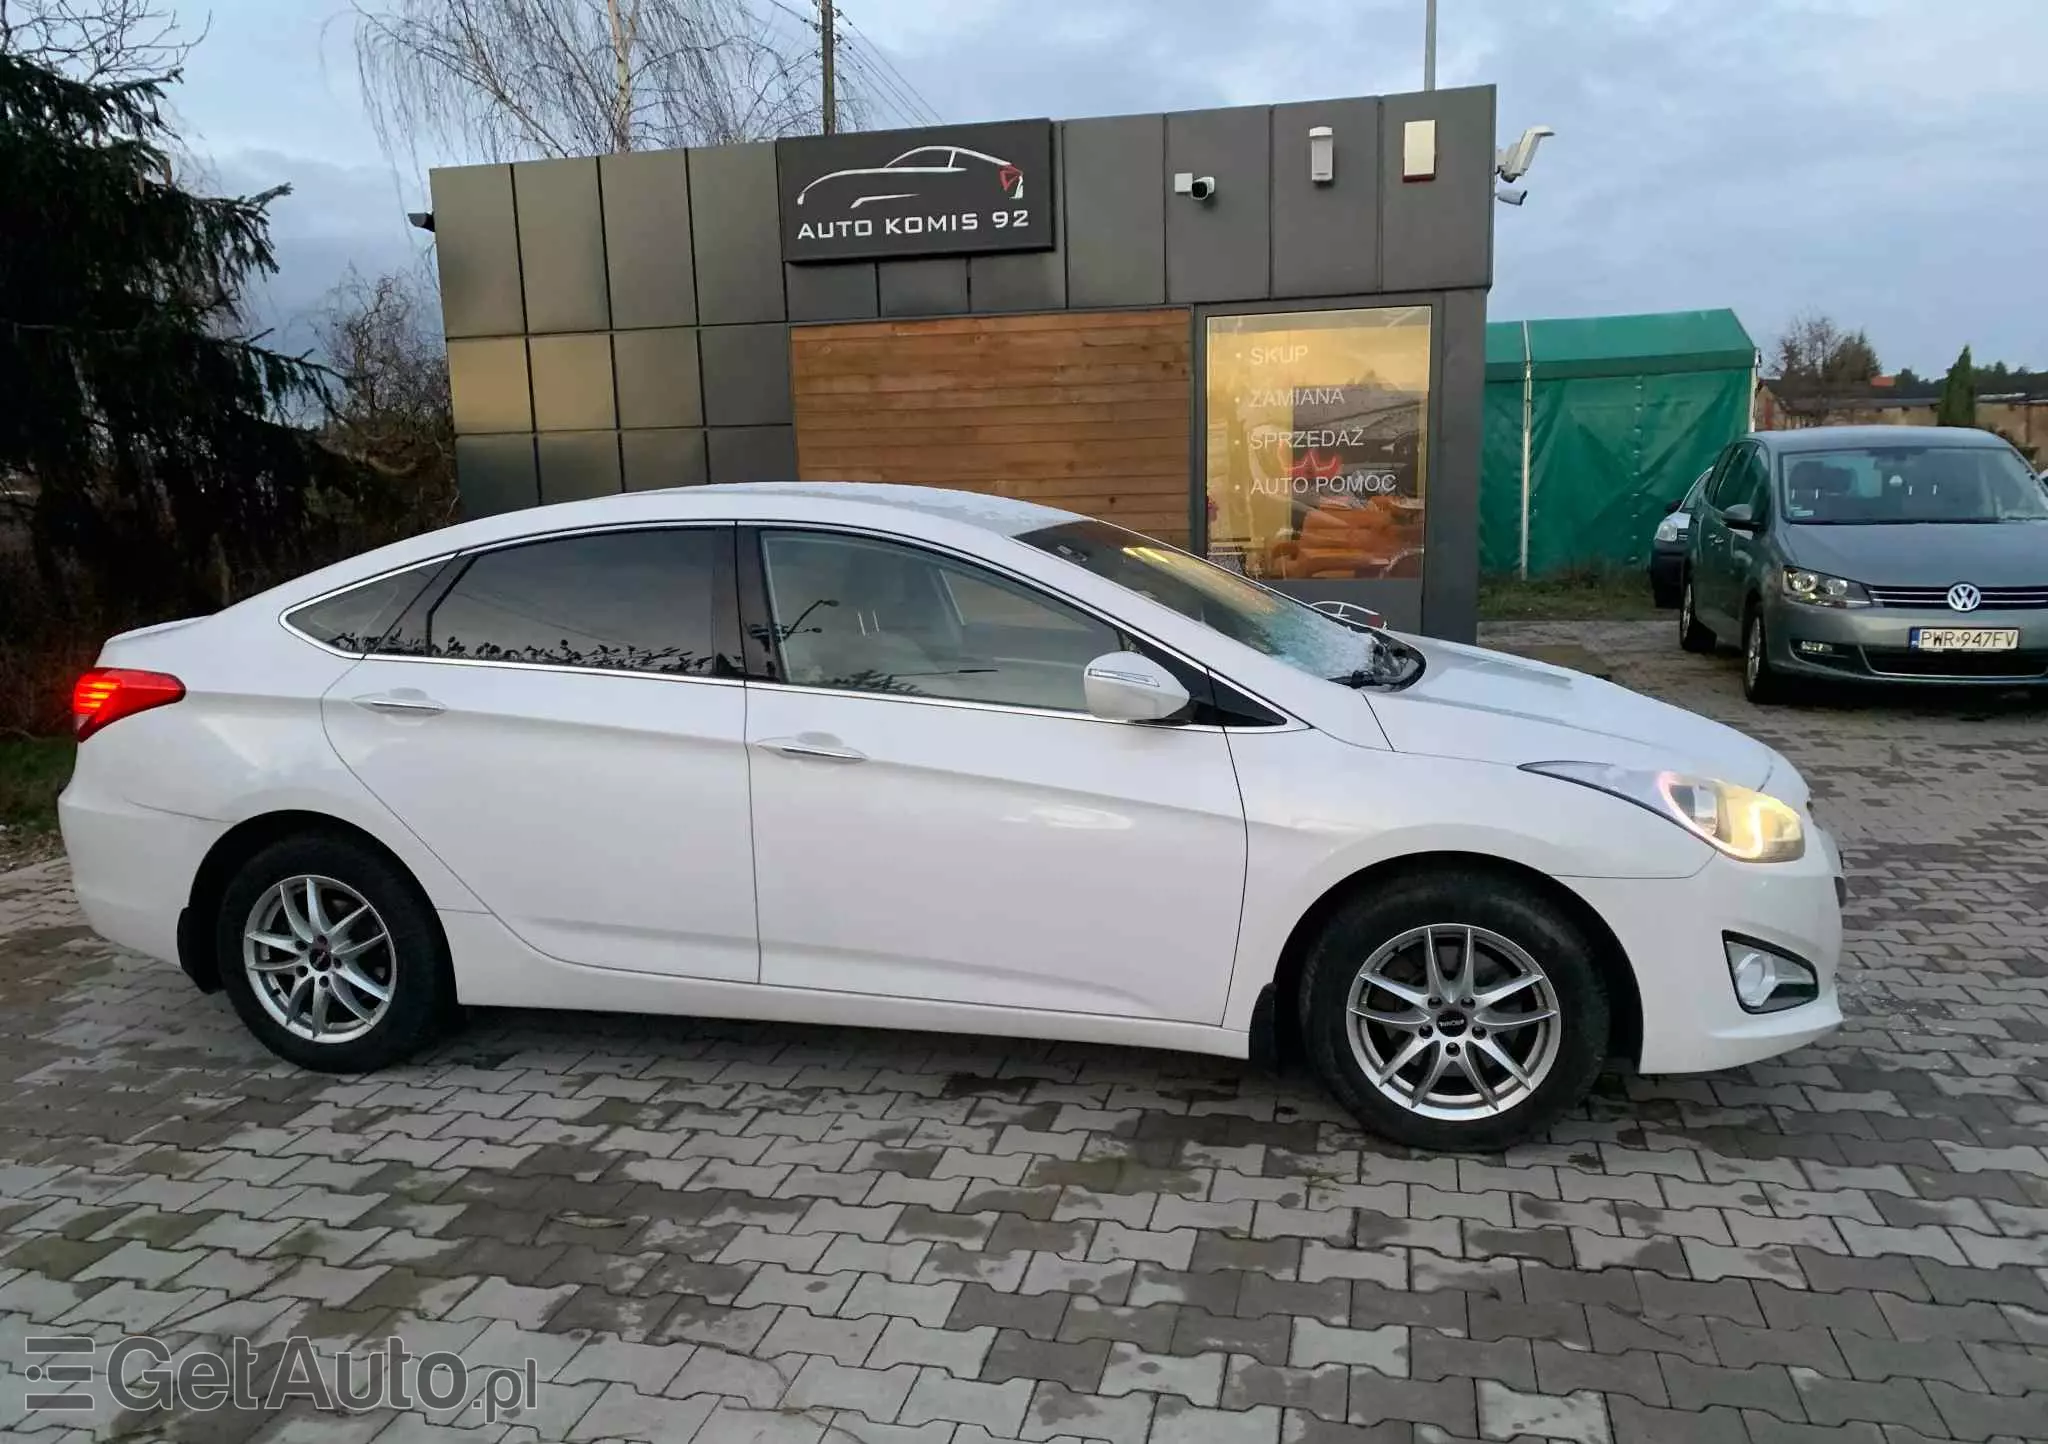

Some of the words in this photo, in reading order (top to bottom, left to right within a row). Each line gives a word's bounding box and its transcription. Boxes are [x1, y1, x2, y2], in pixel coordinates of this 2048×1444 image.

[797, 219, 873, 240] AUTO
[885, 213, 978, 235] KOMIS
[992, 209, 1029, 229] 92
[1250, 345, 1308, 365] SKUP
[1249, 388, 1345, 407] ZAMIANA
[1250, 428, 1364, 449] SPRZEDAŻ
[1250, 477, 1309, 495] AUTO
[1315, 474, 1397, 494] POMOC
